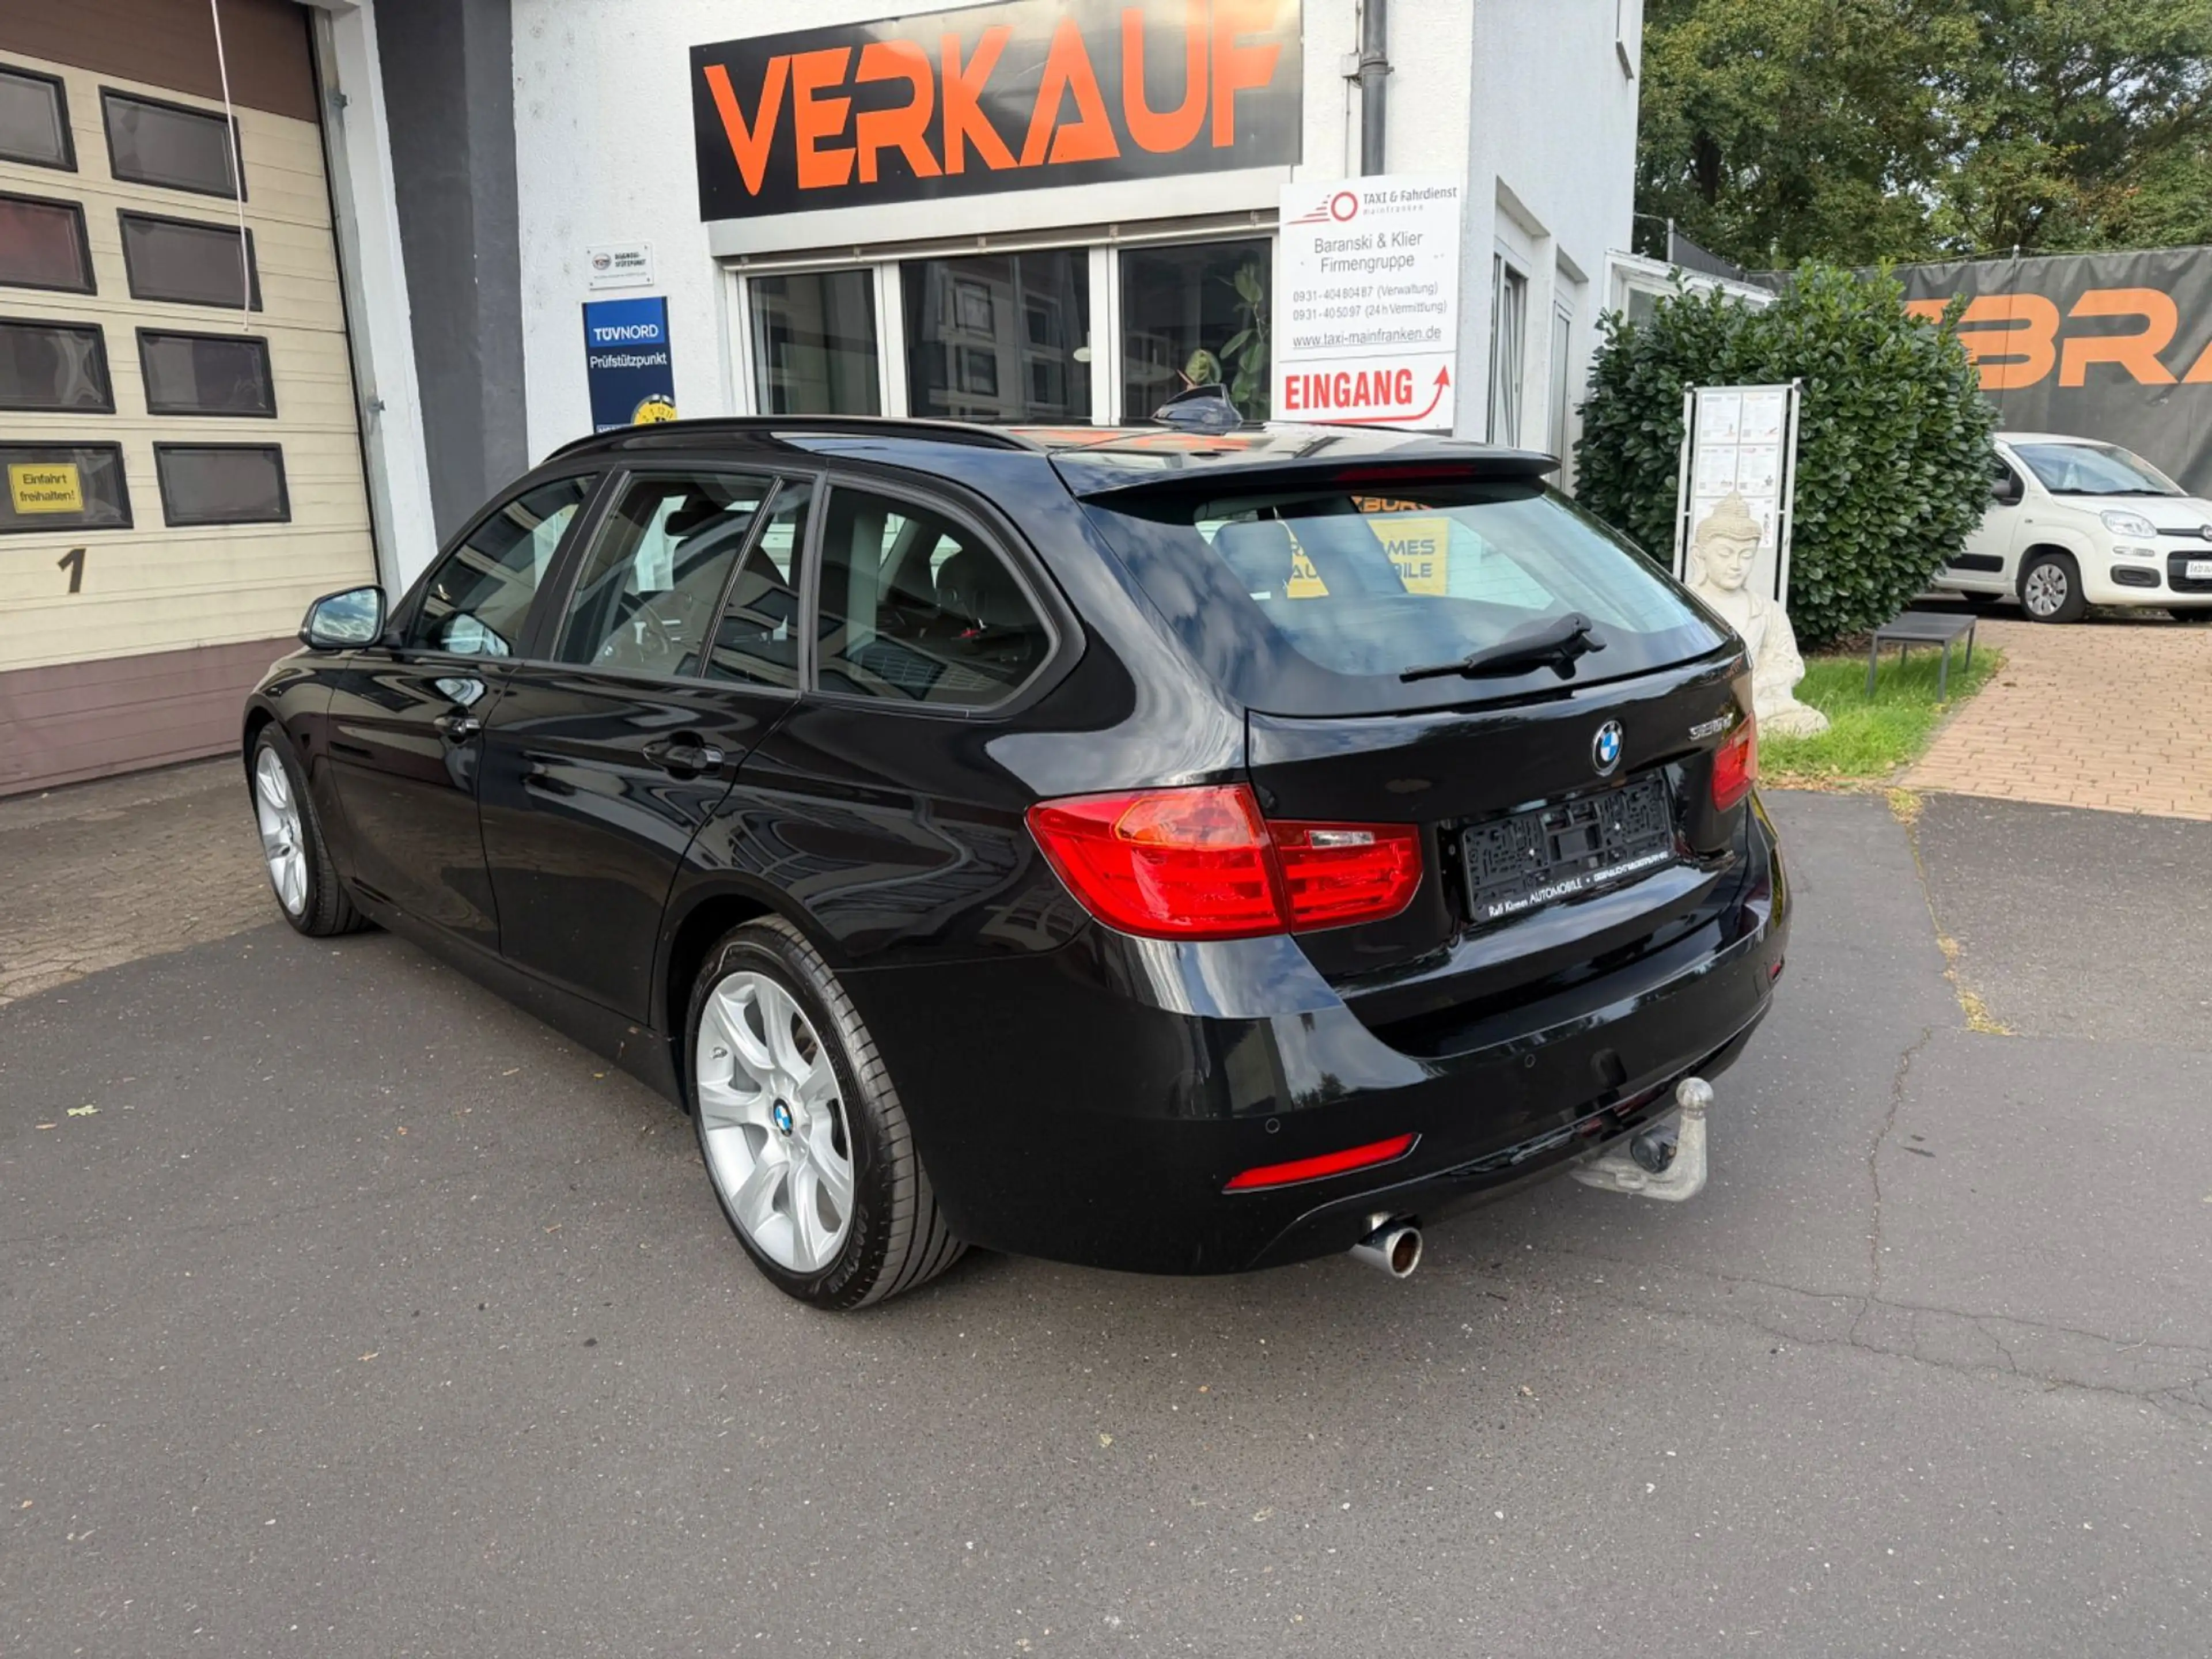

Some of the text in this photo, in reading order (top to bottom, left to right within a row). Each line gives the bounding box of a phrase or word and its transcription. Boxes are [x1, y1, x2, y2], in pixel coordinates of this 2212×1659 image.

[703, 0, 1282, 196] VERKAUF
[1363, 187, 1457, 204] TAXI & Fahrdienst
[1314, 230, 1424, 253] Baranski & Klier
[1320, 254, 1415, 274] Firmengruppe
[1377, 281, 1439, 298] (Verwaltung)
[1293, 305, 1362, 321] 0931-405097
[1293, 325, 1442, 348] www.taxi-mainfranken.de
[590, 352, 668, 369] Prüfstützpunkt
[1285, 368, 1413, 410] EINGANG
[22, 474, 67, 484] Einfahrt
[20, 490, 75, 502] freihalten!
[57, 548, 86, 593] 1
[1529, 877, 1582, 904] AUTOMOBILE
